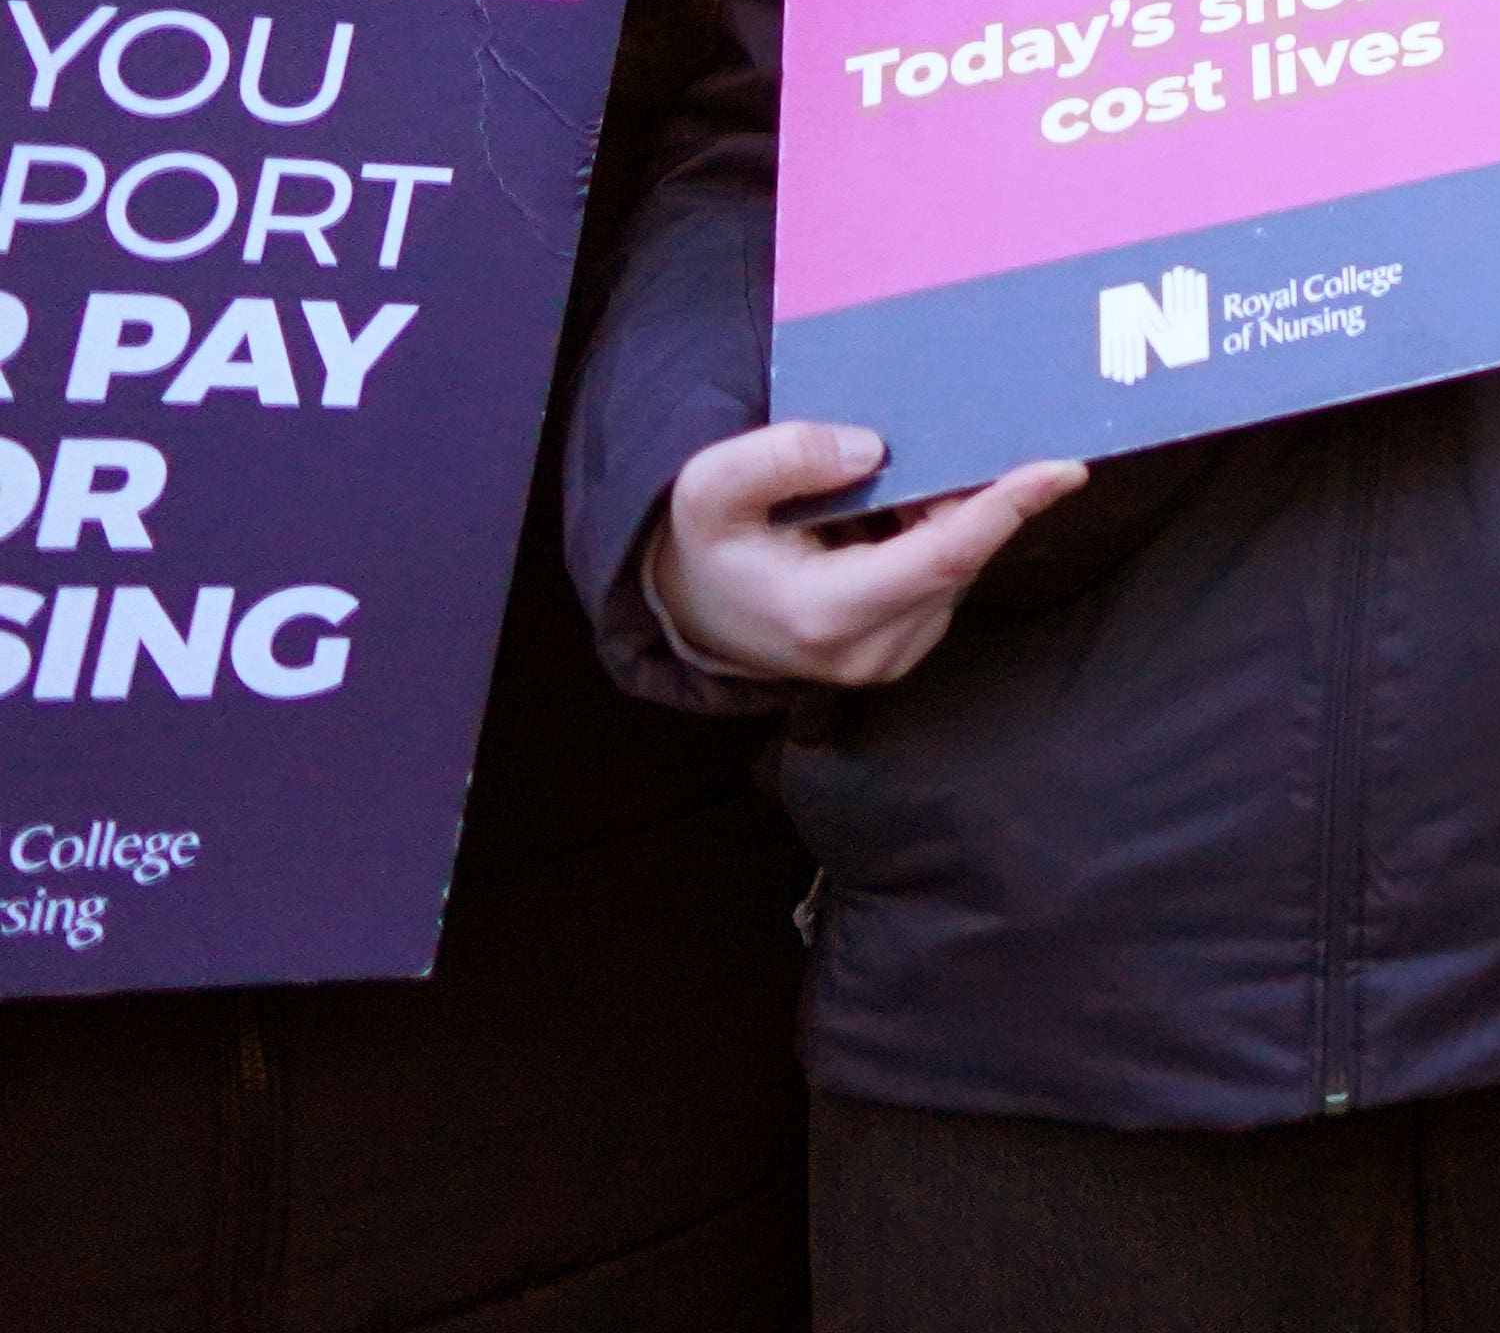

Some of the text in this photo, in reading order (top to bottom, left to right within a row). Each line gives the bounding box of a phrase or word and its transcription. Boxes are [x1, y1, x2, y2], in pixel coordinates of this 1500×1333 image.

[1038, 15, 1444, 144] cost lives
[1223, 262, 1403, 322] Royal College
[65, 290, 421, 410] PAY
[1223, 305, 1367, 355] of Nursing
[10, 819, 200, 884] College
